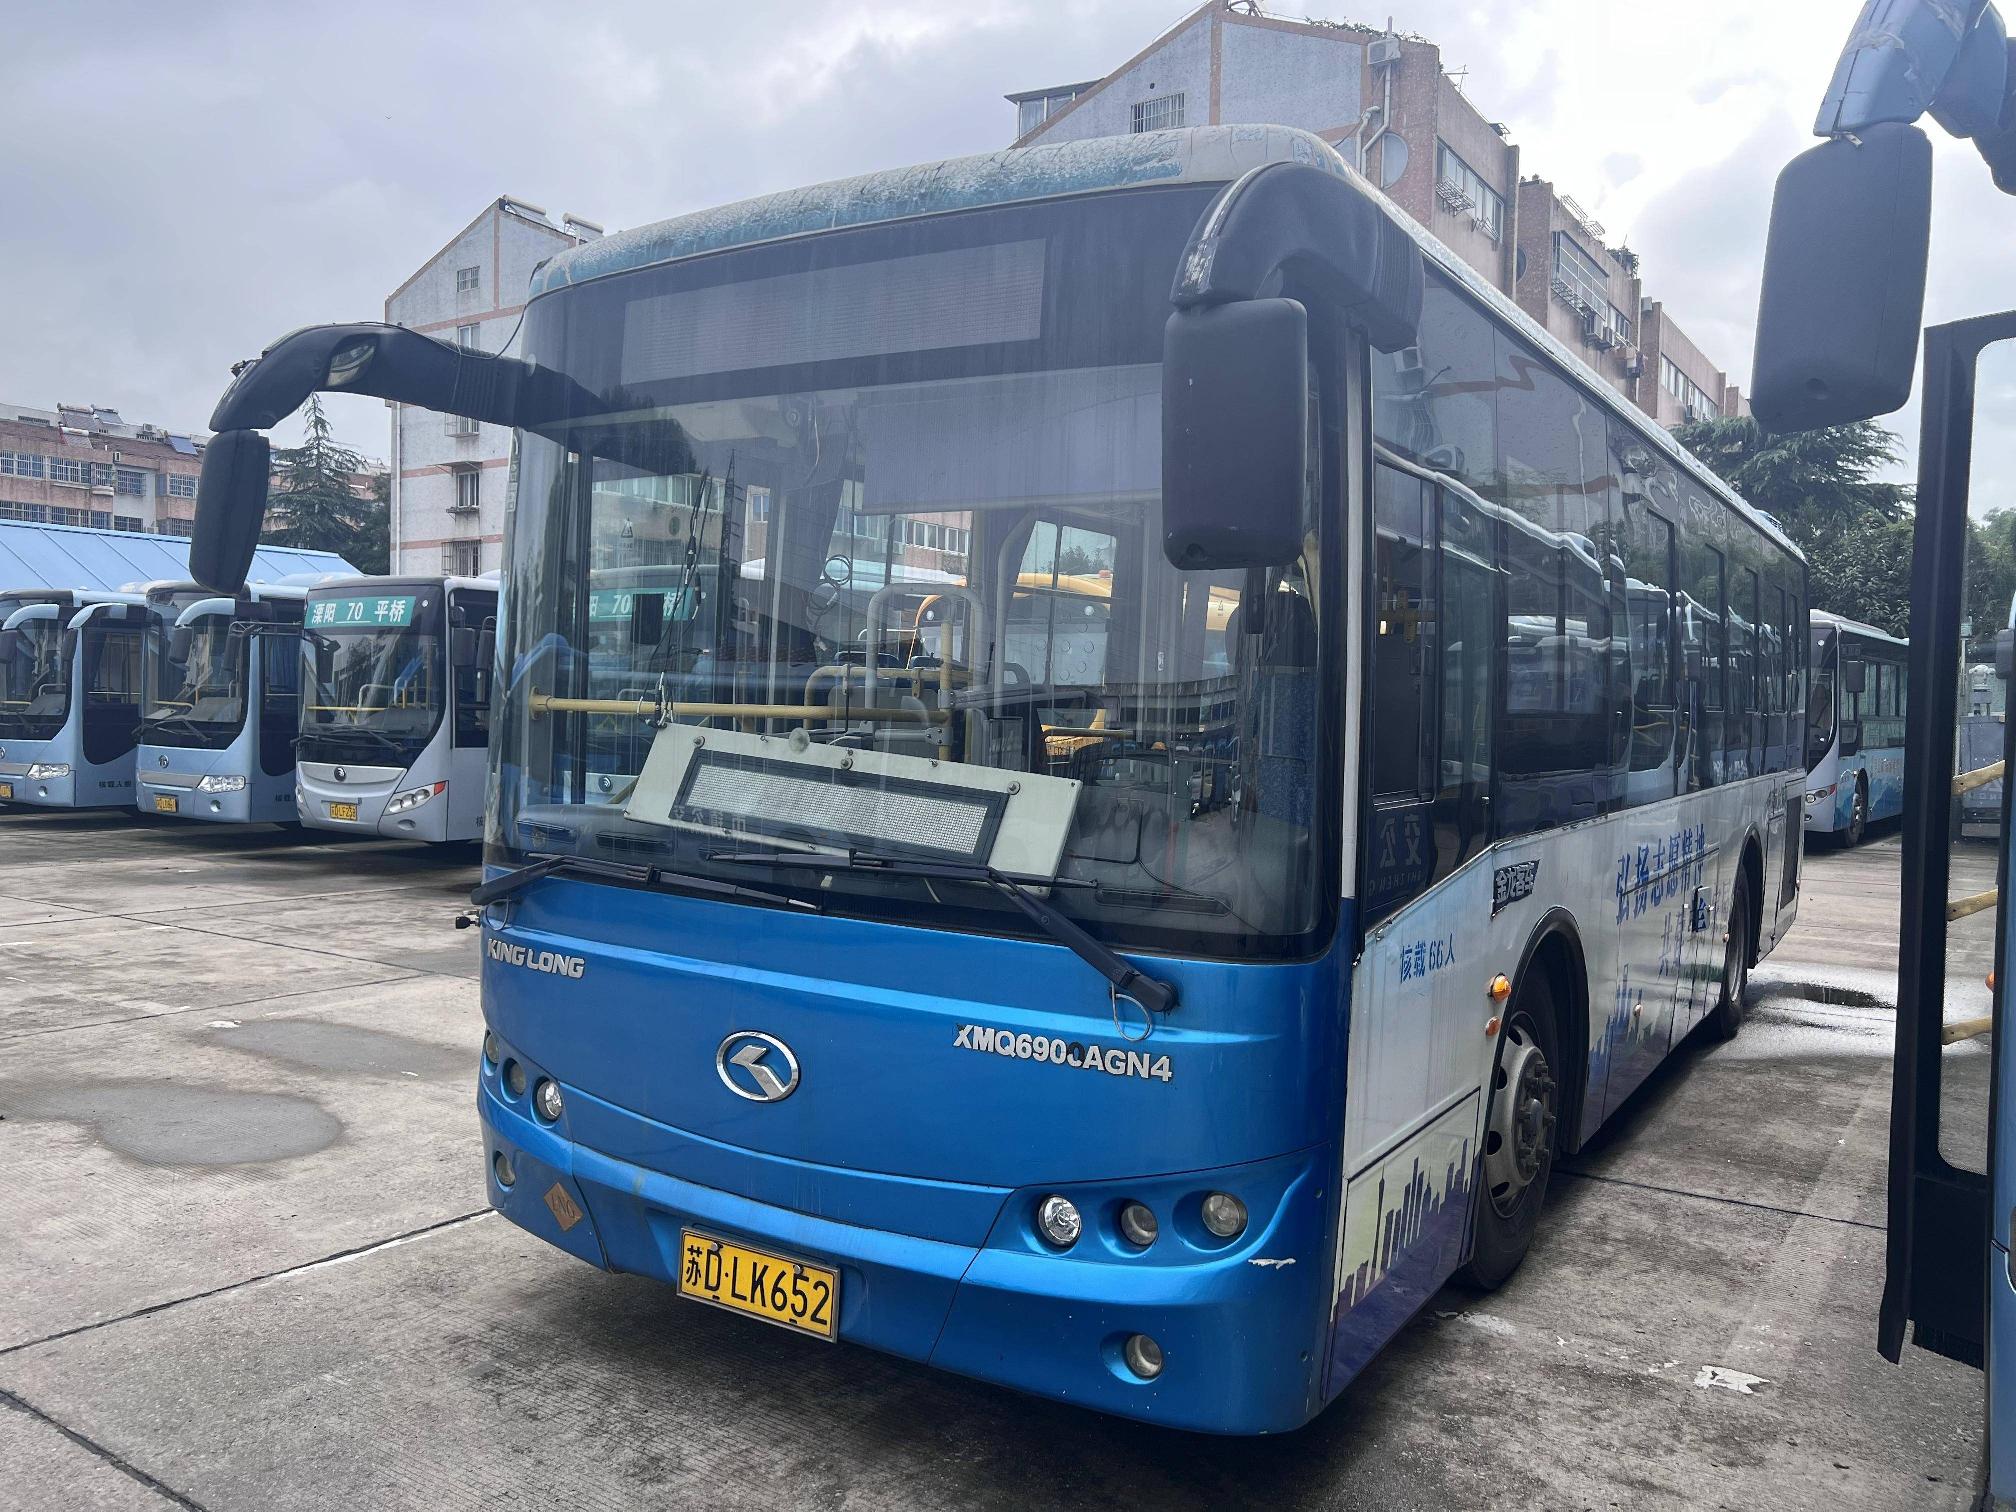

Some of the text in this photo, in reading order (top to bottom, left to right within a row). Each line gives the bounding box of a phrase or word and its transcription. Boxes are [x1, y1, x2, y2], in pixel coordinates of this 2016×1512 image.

[347, 602, 364, 621] 70
[374, 600, 406, 622] 平桥
[612, 594, 631, 614] 70
[1496, 861, 1535, 903] 金龙客车
[487, 938, 585, 979] KING LONG
